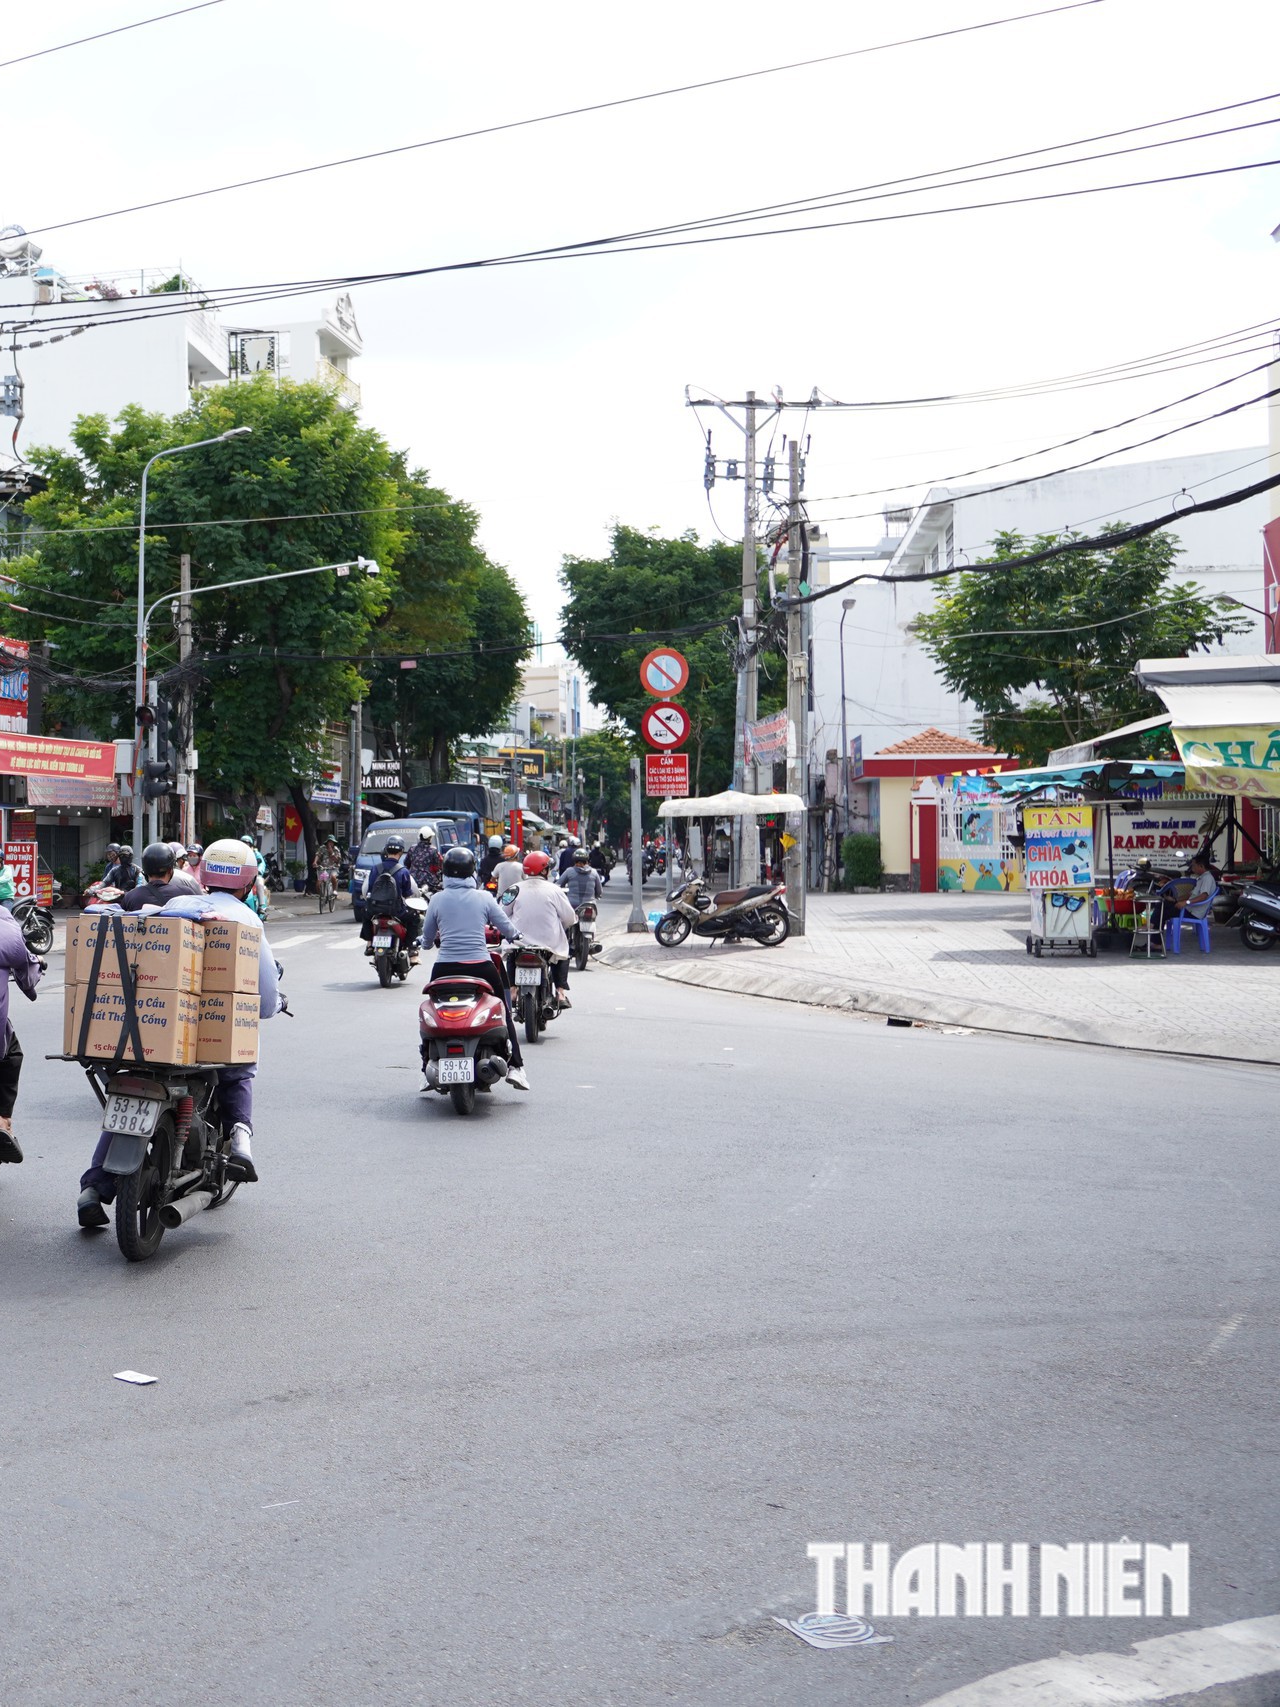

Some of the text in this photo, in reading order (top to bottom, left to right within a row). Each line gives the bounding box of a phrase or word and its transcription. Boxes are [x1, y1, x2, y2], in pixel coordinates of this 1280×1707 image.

[372, 762, 386, 770] MINH
[361, 776, 400, 788] HA KHOA
[1196, 770, 1269, 793] 18A
[1032, 808, 1083, 826] TÂN
[1132, 818, 1160, 830] TRƯỜNG
[1181, 820, 1196, 829] NON
[1113, 831, 1200, 852] RẠNG ĐÔNG
[8, 844, 31, 854] ĐẠI LÝ
[1028, 841, 1062, 862] CHÌA
[9, 862, 31, 878] VÉ
[207, 863, 226, 874] THANH
[1029, 866, 1069, 887] KHÓA
[149, 923, 169, 935] Cầu
[212, 925, 229, 936] Cầu
[144, 940, 171, 954] Cống
[209, 939, 231, 951] Cống
[94, 993, 111, 1005] hất
[146, 997, 166, 1009] Cầu
[207, 998, 224, 1008] Cầu
[90, 1009, 106, 1020] hất
[141, 1013, 168, 1028] Cống
[204, 1011, 226, 1023] Cống
[444, 1060, 469, 1071] 59-K2
[113, 1097, 150, 1117] 53-X4
[109, 1113, 146, 1134] 3984
